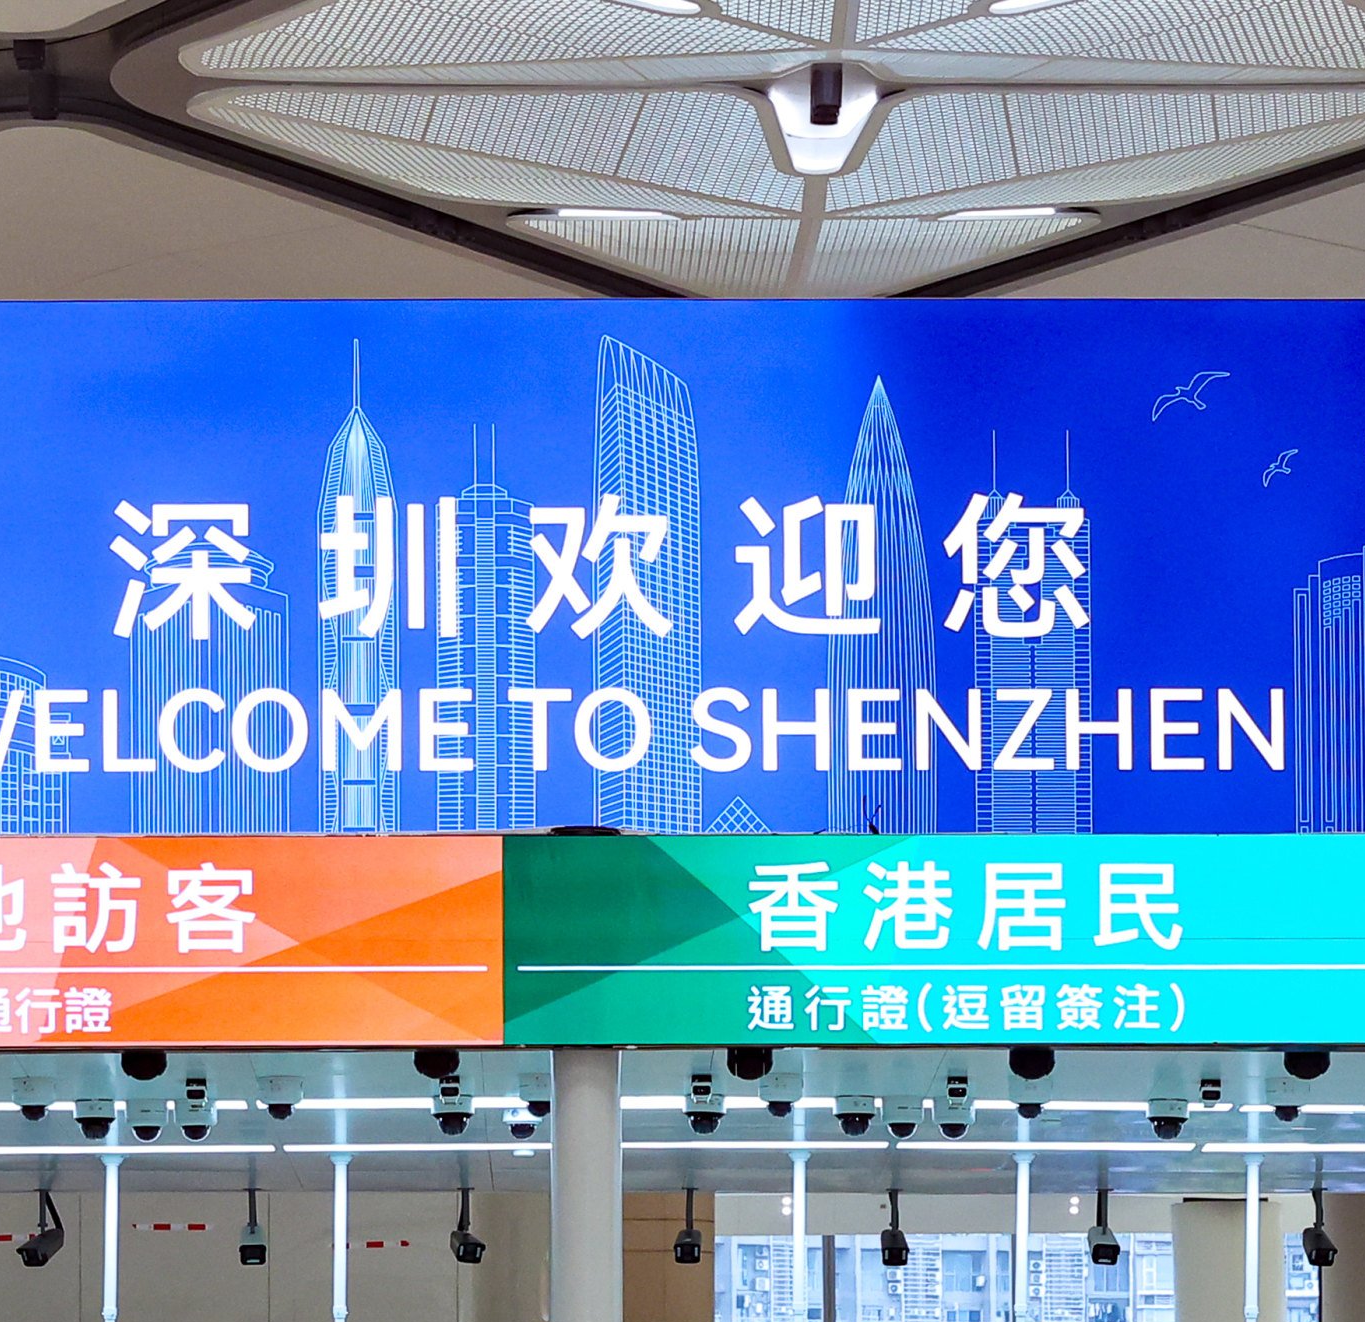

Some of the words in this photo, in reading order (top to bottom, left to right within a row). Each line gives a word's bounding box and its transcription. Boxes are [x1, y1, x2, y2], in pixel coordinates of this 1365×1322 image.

[109, 492, 1091, 641] 深圳欢迎您
[507, 686, 653, 773] TO
[689, 686, 1285, 773] SHENZHEN
[748, 860, 1184, 952] 香港居民
[747, 982, 1185, 1033] 通行證(逗留簽注)
